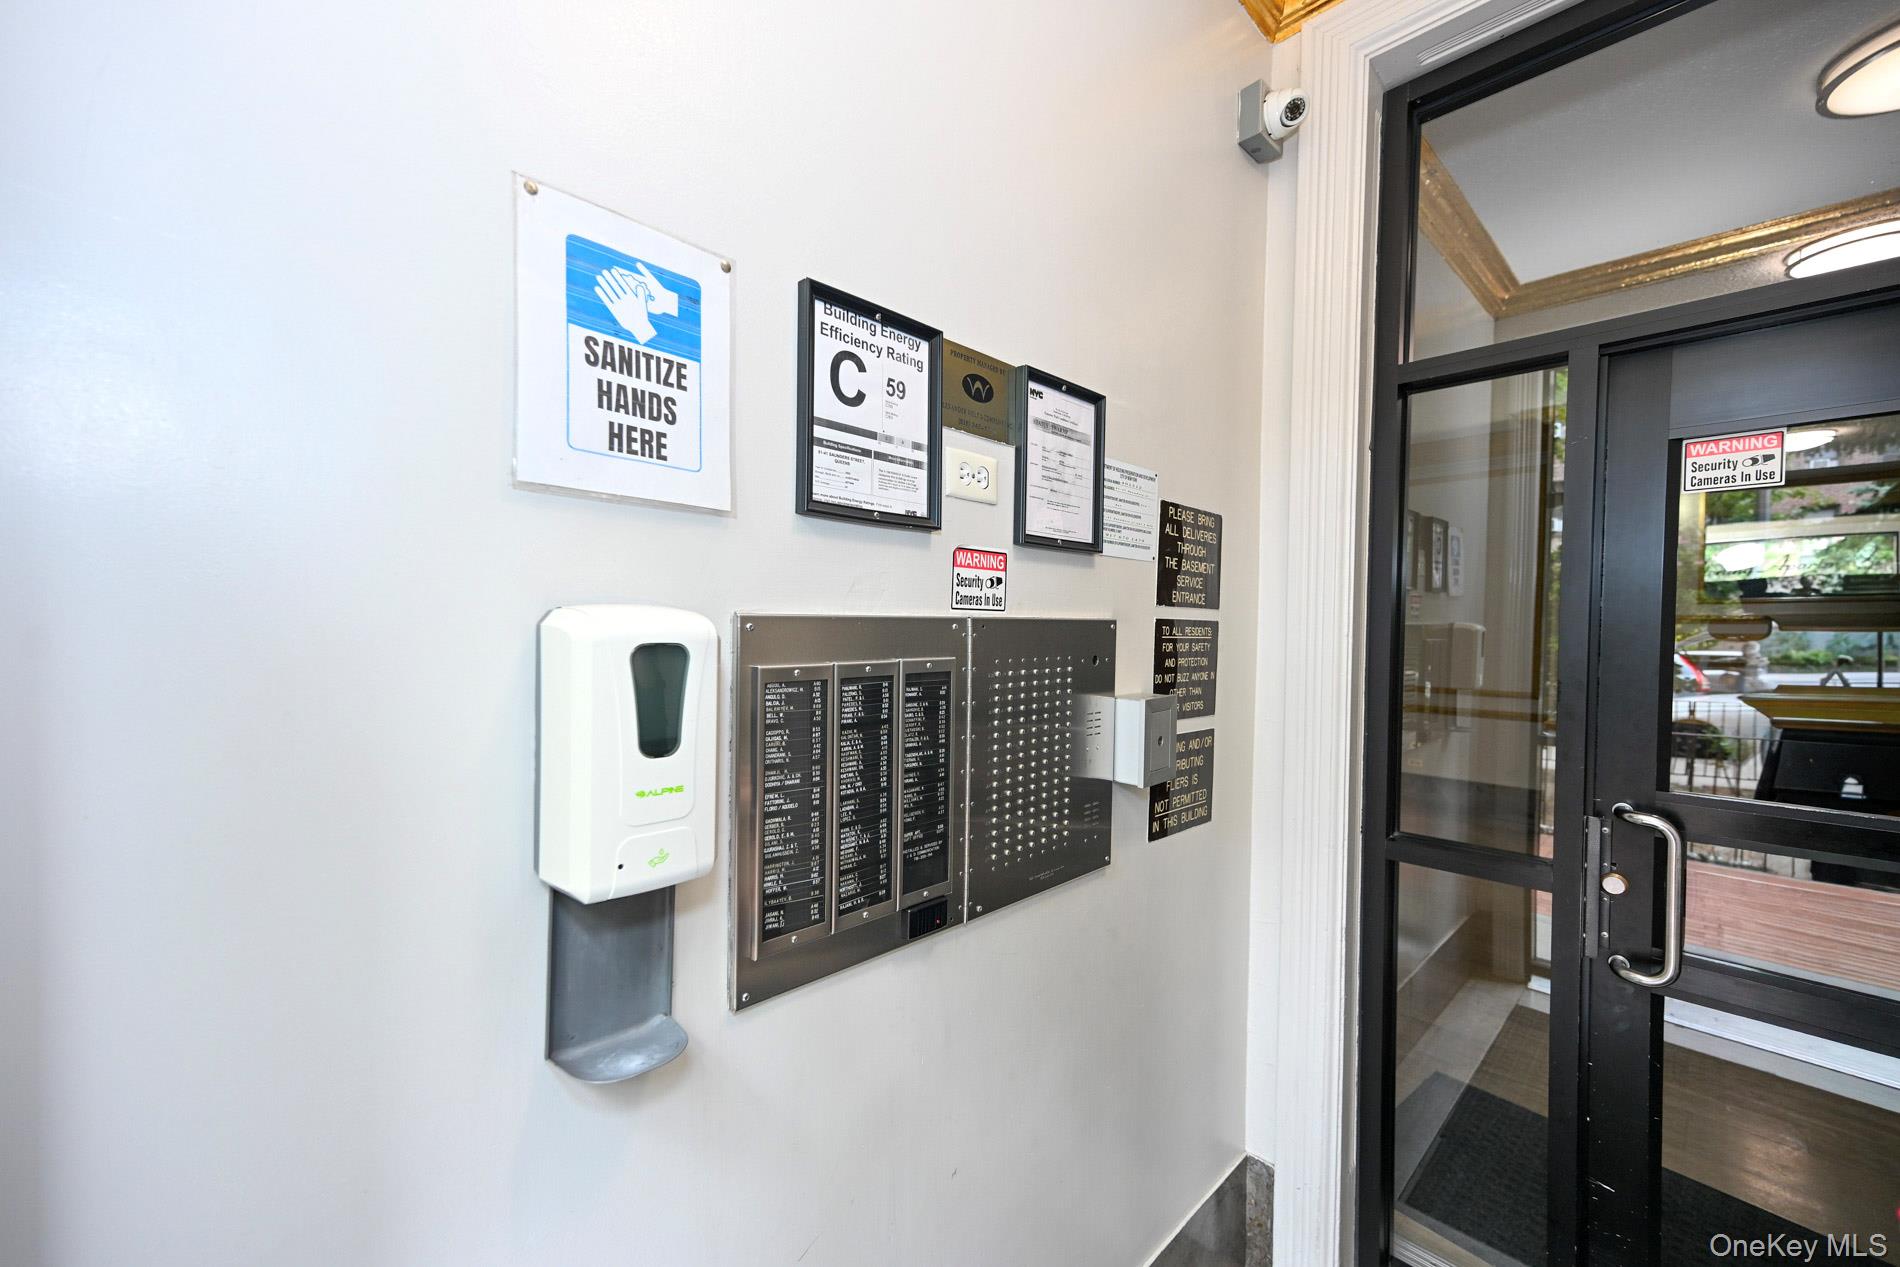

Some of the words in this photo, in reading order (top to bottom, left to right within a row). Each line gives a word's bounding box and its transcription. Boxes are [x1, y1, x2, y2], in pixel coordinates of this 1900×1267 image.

[824, 303, 877, 336] Building
[881, 325, 921, 352] Energy
[820, 321, 882, 358] Efficiency
[887, 346, 923, 372] Rating
[584, 335, 688, 392] SANITIZE
[830, 350, 867, 408] C
[886, 377, 906, 400] 59
[597, 378, 677, 426] HANDS
[1030, 387, 1043, 399] NYC
[608, 420, 668, 462] HERE
[1689, 435, 1778, 456] WARNING
[1691, 458, 1738, 473] Security
[1690, 474, 1737, 488] Cameras
[1741, 471, 1751, 483] In
[1755, 469, 1776, 481] Use
[1168, 506, 1195, 524] PLEASE
[1197, 513, 1215, 529] BRING
[1164, 523, 1179, 537] ALL
[1182, 526, 1217, 544] DELIVERIES
[956, 550, 1005, 570] WARNING
[1165, 556, 1179, 570] THE
[1181, 559, 1215, 575] BASEMENT
[956, 572, 984, 591] Security
[1176, 575, 1203, 589] SERVICE
[955, 591, 983, 606] Cameras
[984, 592, 990, 606] In
[992, 593, 1003, 607] Use
[1172, 590, 1206, 605] ENTRANCE
[1162, 626, 1170, 636] TO
[1172, 626, 1183, 636] ALL
[1162, 642, 1174, 652] FOR
[1176, 642, 1190, 652] YOUR
[1192, 642, 1211, 652] SAFETY
[1164, 658, 1176, 668] AND
[1177, 657, 1208, 668] PROTECTION
[1155, 674, 1162, 684] DO
[1164, 673, 1175, 683] NOT
[1177, 673, 1190, 682] BUZZ
[1192, 671, 1209, 681] ANYONE
[1169, 687, 1187, 697] OTHER
[1189, 687, 1202, 696] THAN
[1182, 701, 1204, 711] VISITORS
[1188, 735, 1213, 751] AND/OR
[1176, 755, 1204, 770] RIBUTING
[1166, 776, 1189, 792] FLIERS
[1192, 773, 1199, 785] IS
[1154, 799, 1169, 814] NOT
[1172, 788, 1208, 808] PERMITTED
[1152, 821, 1160, 833] IN
[1163, 815, 1178, 829] THIS
[1181, 805, 1208, 824] BUILDING
